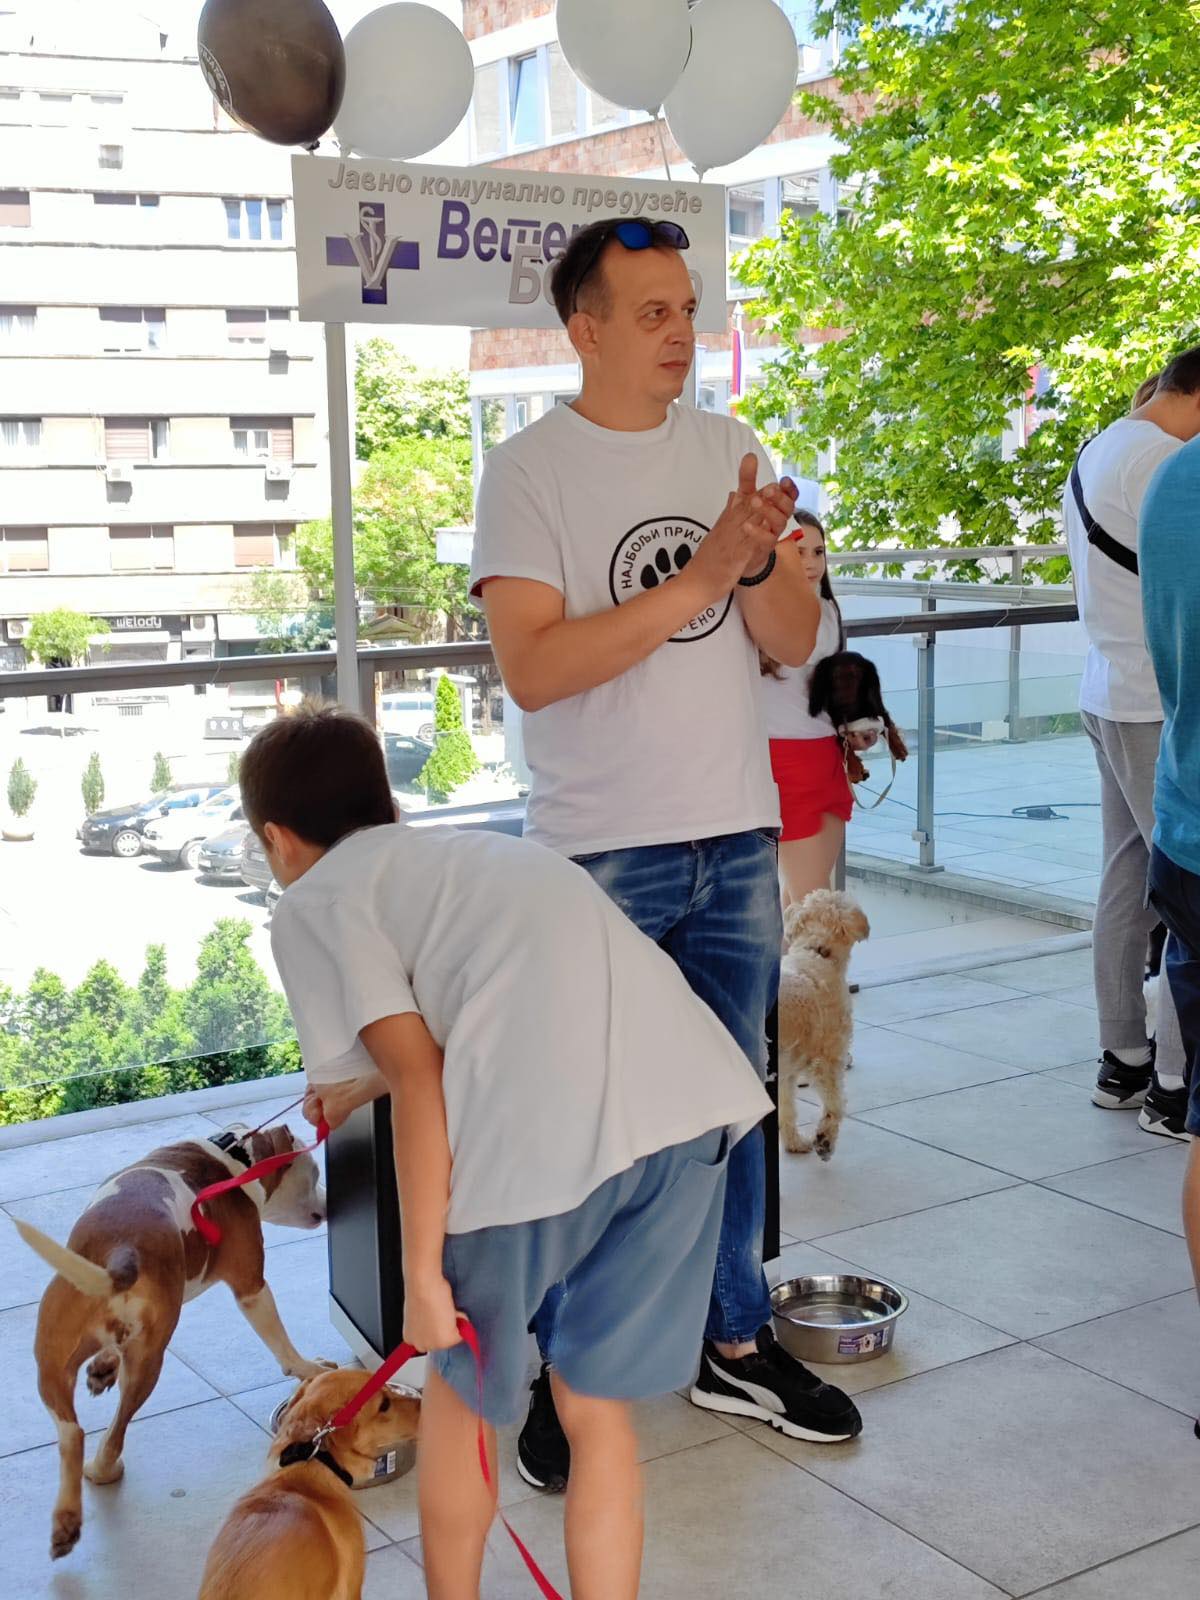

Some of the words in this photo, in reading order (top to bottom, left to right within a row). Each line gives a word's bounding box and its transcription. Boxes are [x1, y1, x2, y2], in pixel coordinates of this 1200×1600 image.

[328, 163, 412, 194] Јавно
[420, 176, 565, 205] комунално
[572, 185, 703, 216] предузеће
[621, 528, 661, 590] НАЈБОЉИ
[664, 526, 703, 544] ПРИЈ
